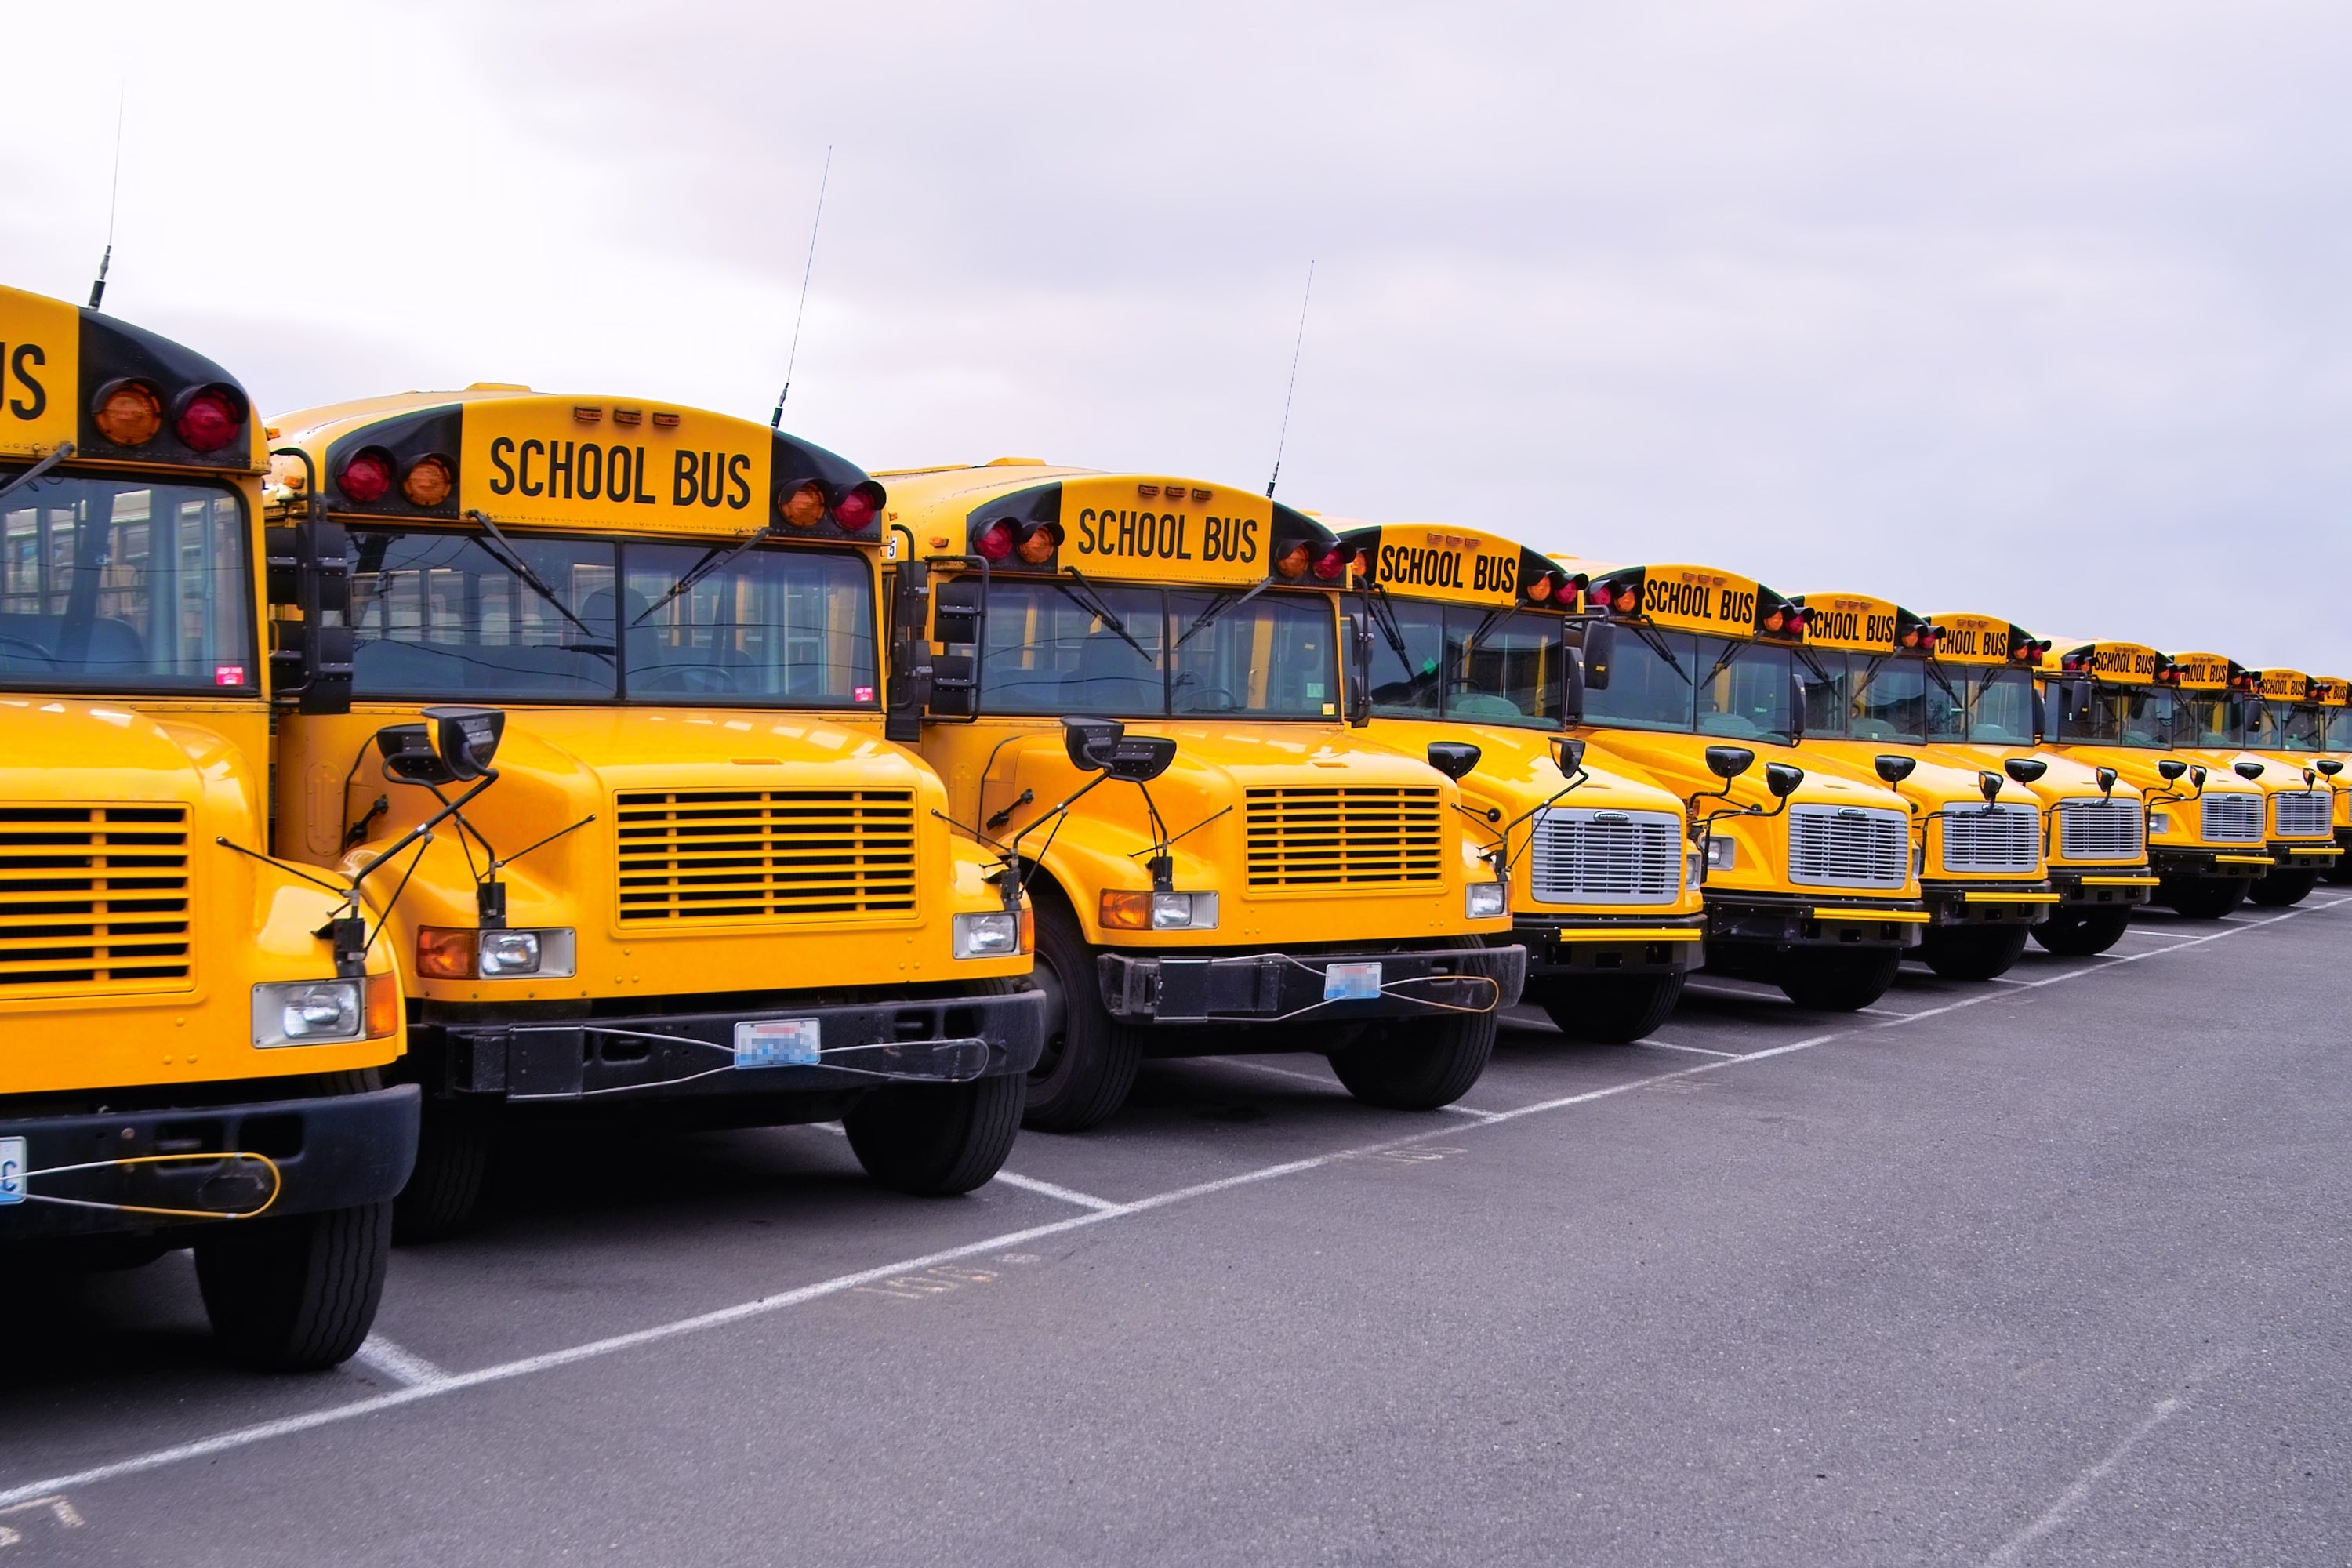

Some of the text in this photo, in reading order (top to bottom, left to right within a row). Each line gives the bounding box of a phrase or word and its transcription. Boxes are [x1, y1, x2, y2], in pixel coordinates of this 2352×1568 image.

[0, 342, 46, 420] S
[489, 437, 750, 509] SCHOOL BUS
[1078, 508, 1258, 563] SCHOOL BUS
[1380, 545, 1515, 593] SCHOOL BUS
[1645, 579, 1754, 624] SCHOOL BUS
[1866, 615, 1894, 643] BUS
[1938, 630, 2006, 656] CHOOL BUS
[2095, 652, 2154, 674] SCHOOL BUS
[2182, 664, 2227, 682] HOOL BUS
[2261, 679, 2304, 695] SCHOOL BUS
[2333, 685, 2347, 699] BUS
